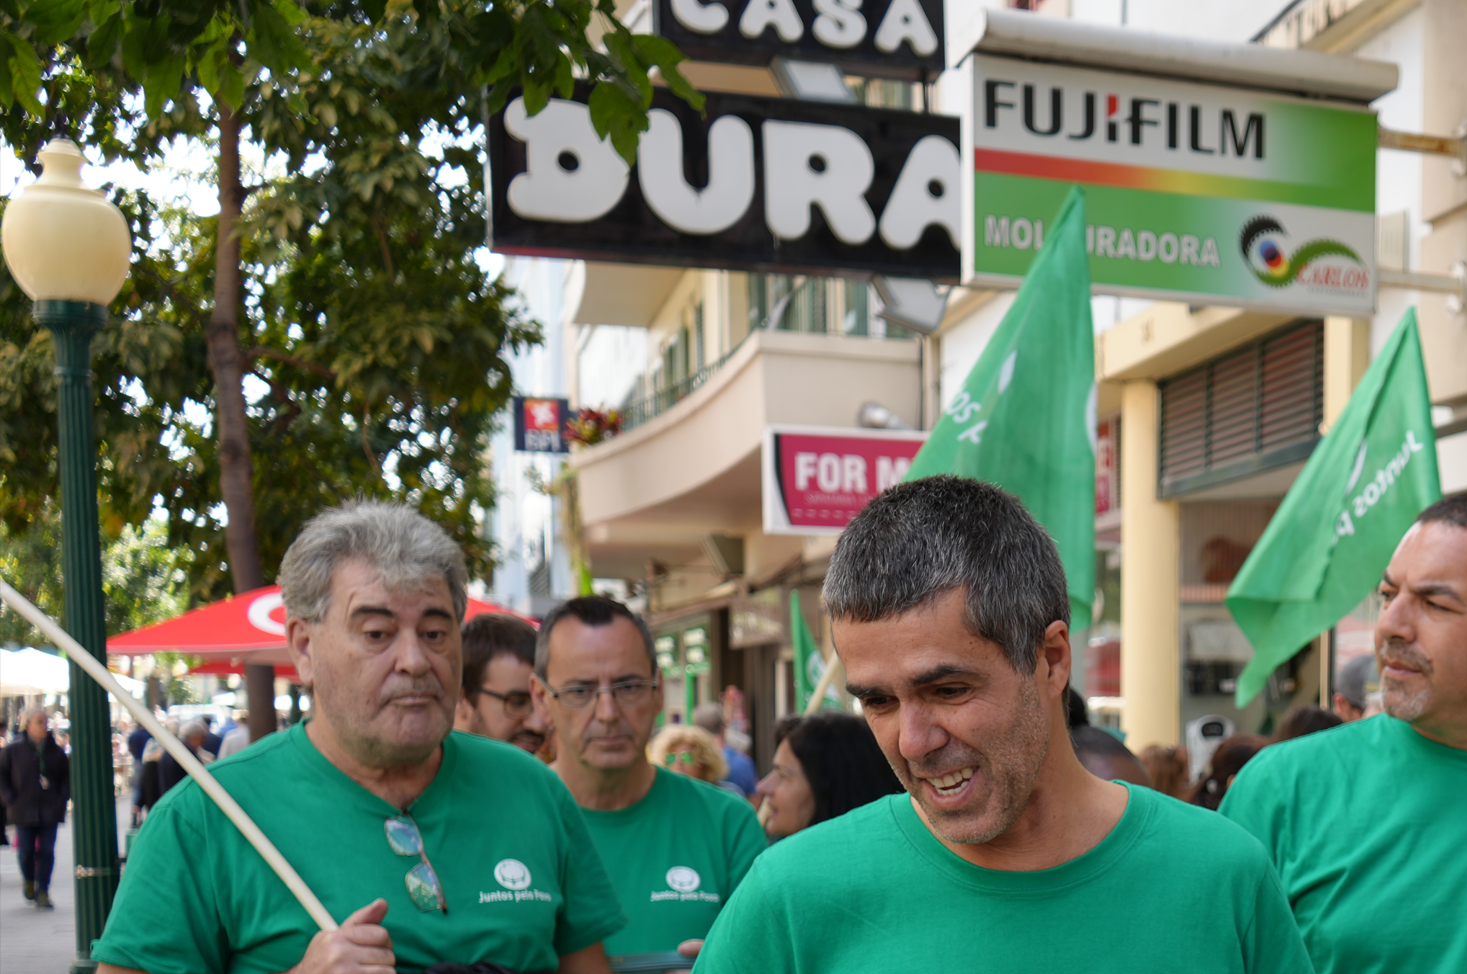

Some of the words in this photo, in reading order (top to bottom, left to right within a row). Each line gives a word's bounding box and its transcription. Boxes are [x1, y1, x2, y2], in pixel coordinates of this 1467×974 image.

[983, 79, 1266, 159] FUJIFILM
[984, 214, 1222, 268] MOLURADORA
[479, 890, 513, 903] Juntos
